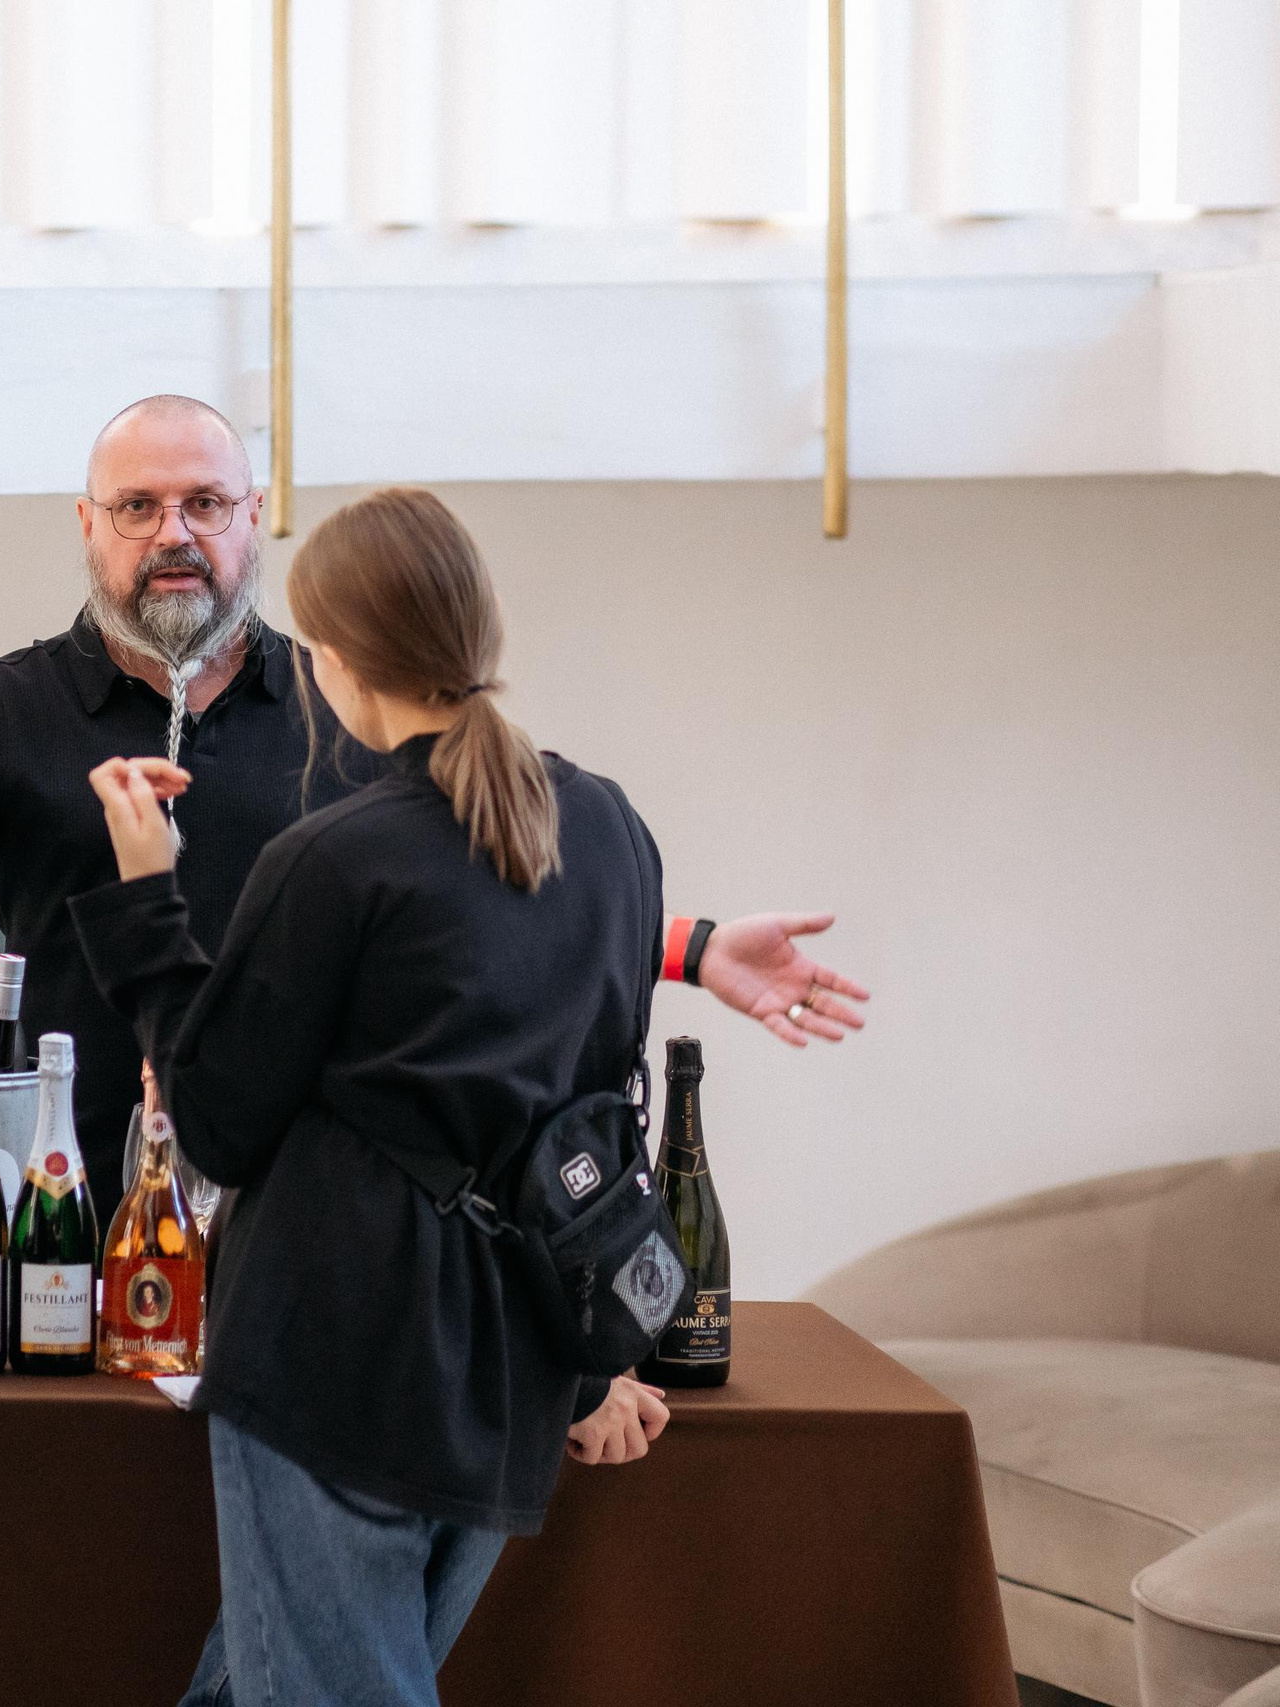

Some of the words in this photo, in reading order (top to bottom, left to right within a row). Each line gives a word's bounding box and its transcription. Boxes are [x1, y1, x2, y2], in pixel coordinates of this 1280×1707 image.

[685, 1091, 693, 1116] SERRA
[685, 1118, 694, 1141] JAUME
[24, 1292, 89, 1305] FESTILLANT
[672, 1317, 706, 1328] AUME
[124, 1340, 140, 1353] von
